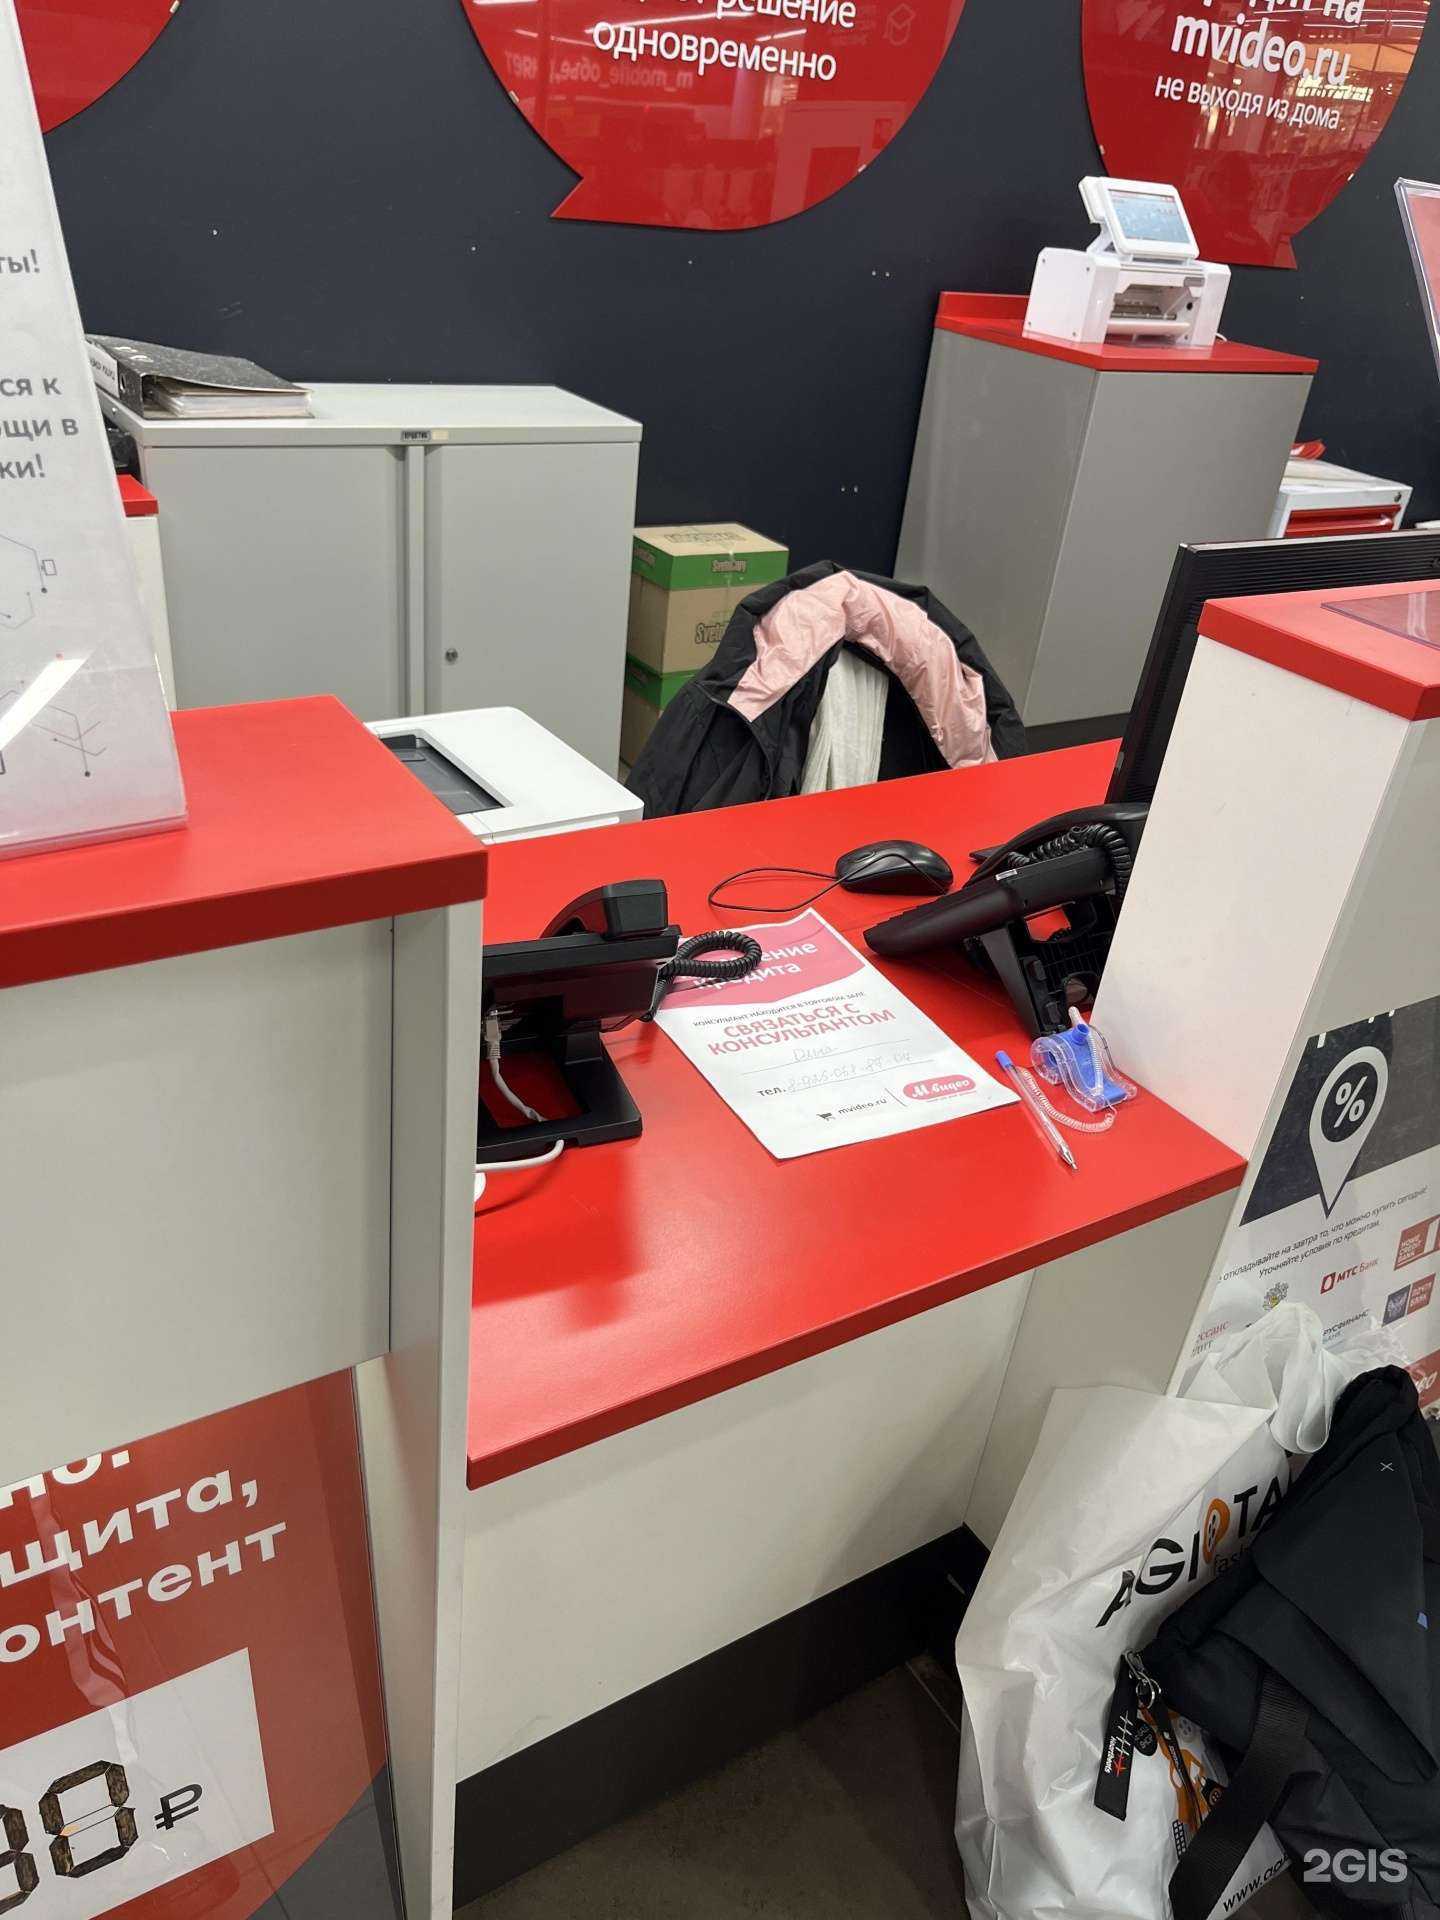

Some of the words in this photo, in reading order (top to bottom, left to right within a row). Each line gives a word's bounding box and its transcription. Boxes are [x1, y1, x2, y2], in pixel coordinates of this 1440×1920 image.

[592, 21, 838, 81] одновременно
[1171, 13, 1351, 86] mvideo.ru
[1154, 75, 1185, 101] не
[1187, 82, 1264, 118] выходя
[1265, 97, 1289, 120] из
[1289, 103, 1341, 129] дома
[42, 378, 62, 395] к
[0, 419, 52, 441] щи
[61, 418, 79, 435] в
[707, 1008, 896, 1056] КОНСУЛЬТАНТОМ
[724, 1005, 842, 1038] СВЯЗАТЬСЯ
[844, 1003, 860, 1014] С
[757, 1086, 786, 1098] тел.
[838, 1097, 888, 1116] mvideo.ru
[1331, 1235, 1344, 1245] по
[1336, 1265, 1358, 1283] МТС
